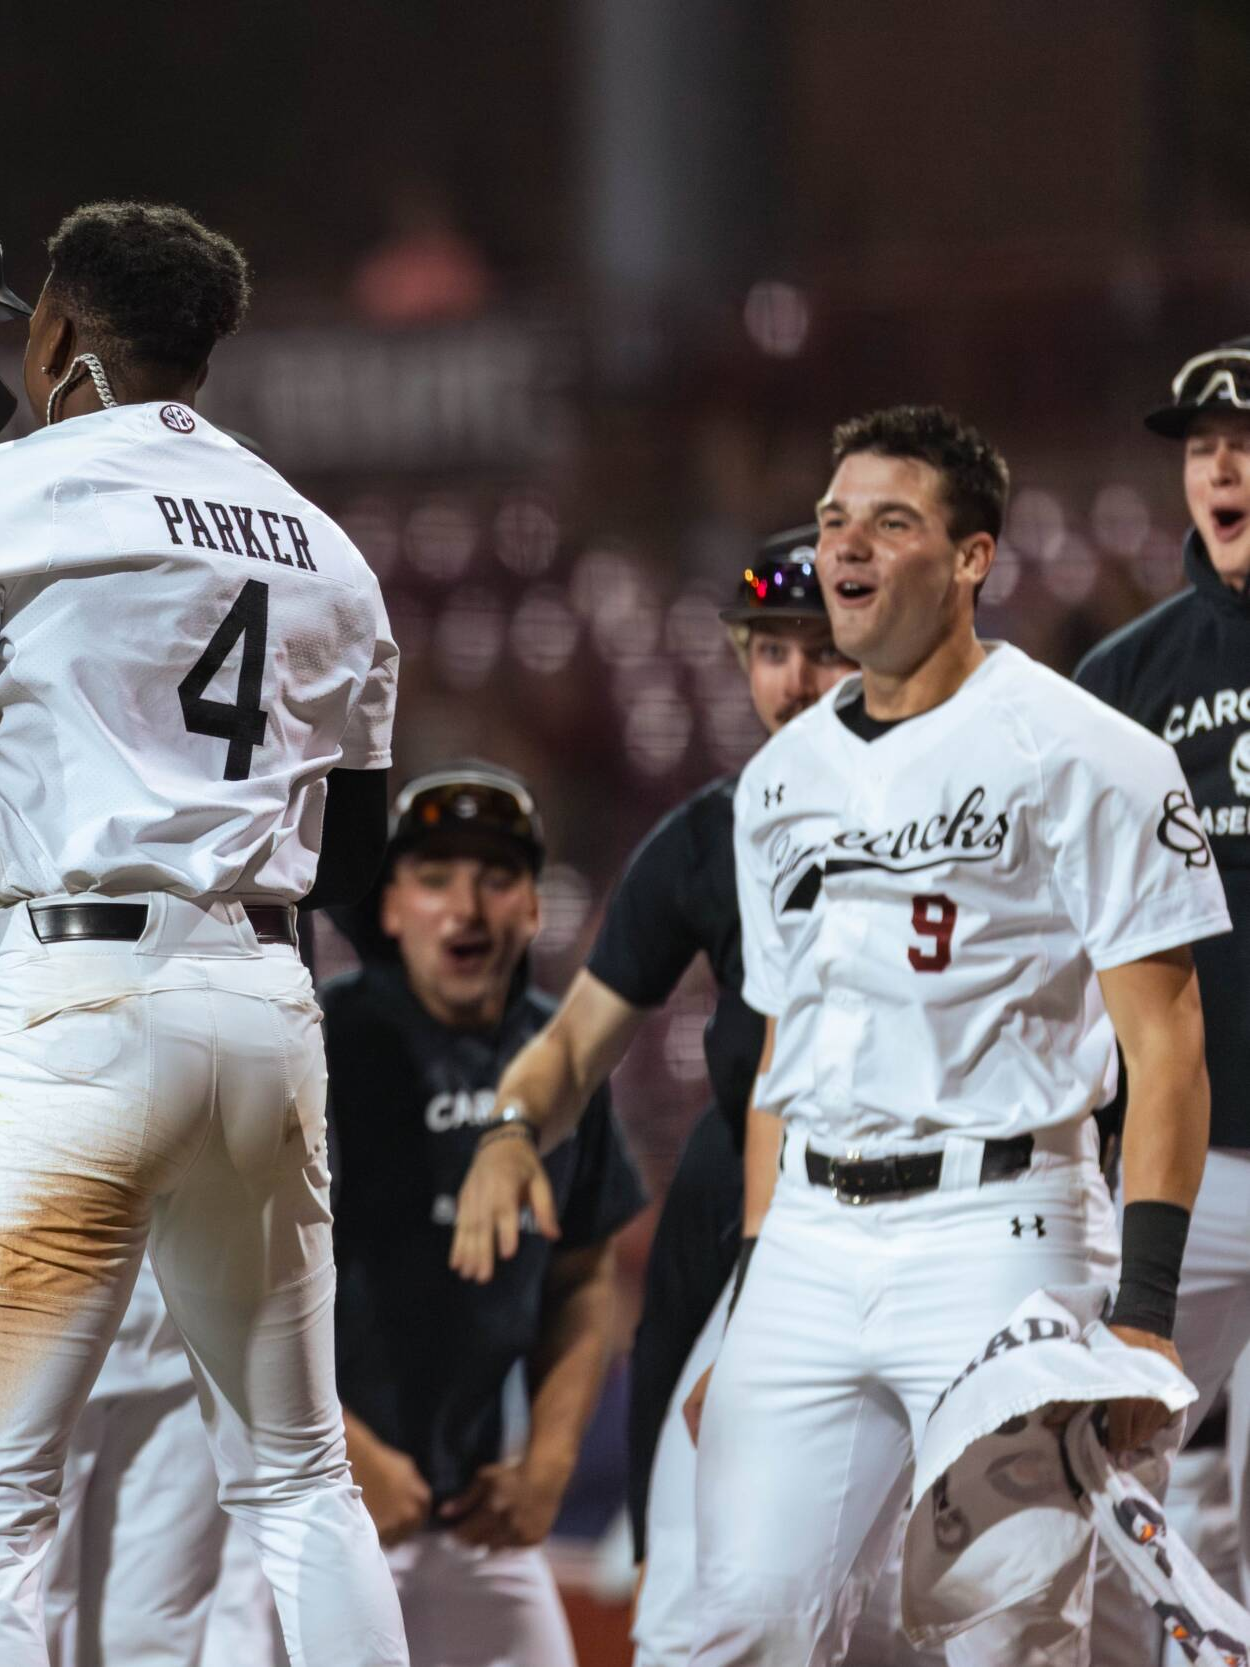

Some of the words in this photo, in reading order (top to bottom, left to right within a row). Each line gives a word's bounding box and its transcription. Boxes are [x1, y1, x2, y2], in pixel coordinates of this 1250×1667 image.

[160, 404, 196, 434] SEC
[153, 495, 318, 573] PARKER
[177, 578, 270, 782] 4
[907, 893, 958, 973] 9
